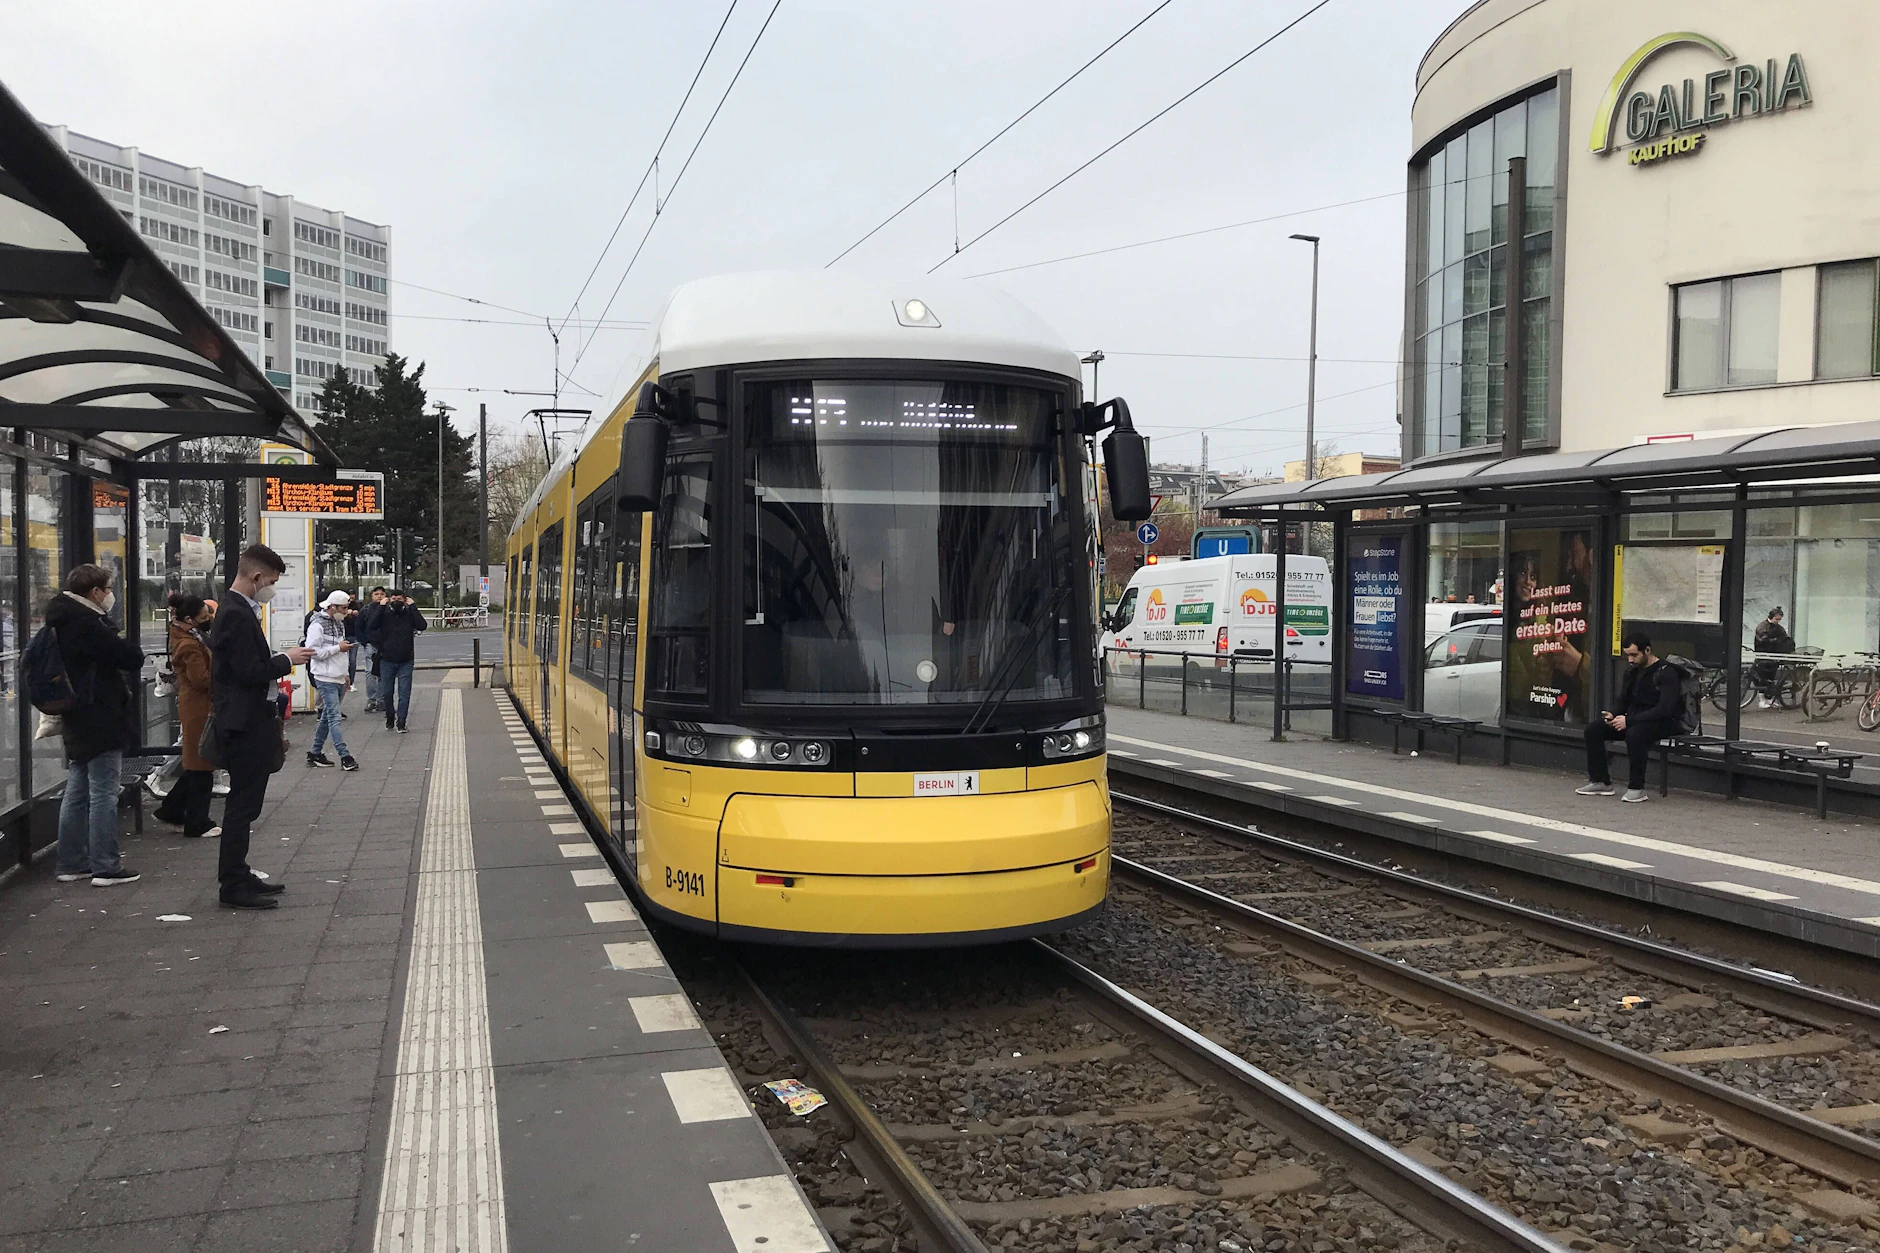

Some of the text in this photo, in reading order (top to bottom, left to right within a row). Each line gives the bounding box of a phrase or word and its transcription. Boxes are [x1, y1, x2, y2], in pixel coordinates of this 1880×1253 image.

[1626, 53, 1813, 142] GALERIA
[1218, 539, 1229, 556] U
[1235, 571, 1253, 579] Tel.:
[1256, 571, 1277, 579] 0152
[1287, 572, 1302, 580] 955
[1354, 571, 1371, 583] Spielt
[1378, 572, 1387, 581] im
[1387, 572, 1399, 582] Job
[1354, 584, 1403, 596] eine Rolle, ob du
[1530, 584, 1571, 598] Lasst uns
[1355, 598, 1394, 609] Männer oder
[1520, 601, 1582, 618] auf ein letztes
[1355, 612, 1397, 623] Frauen liebst?
[1143, 631, 1155, 641] Tel.:
[1155, 630, 1173, 641] 01520
[1176, 630, 1187, 641] 955
[1187, 630, 1197, 640] 77
[1197, 629, 1205, 640] 77
[1515, 618, 1586, 638] erstes Date
[1532, 640, 1563, 656] gehen.
[1530, 691, 1556, 708] Parship
[918, 779, 954, 790] BERLIN
[665, 866, 705, 897] B-9141
